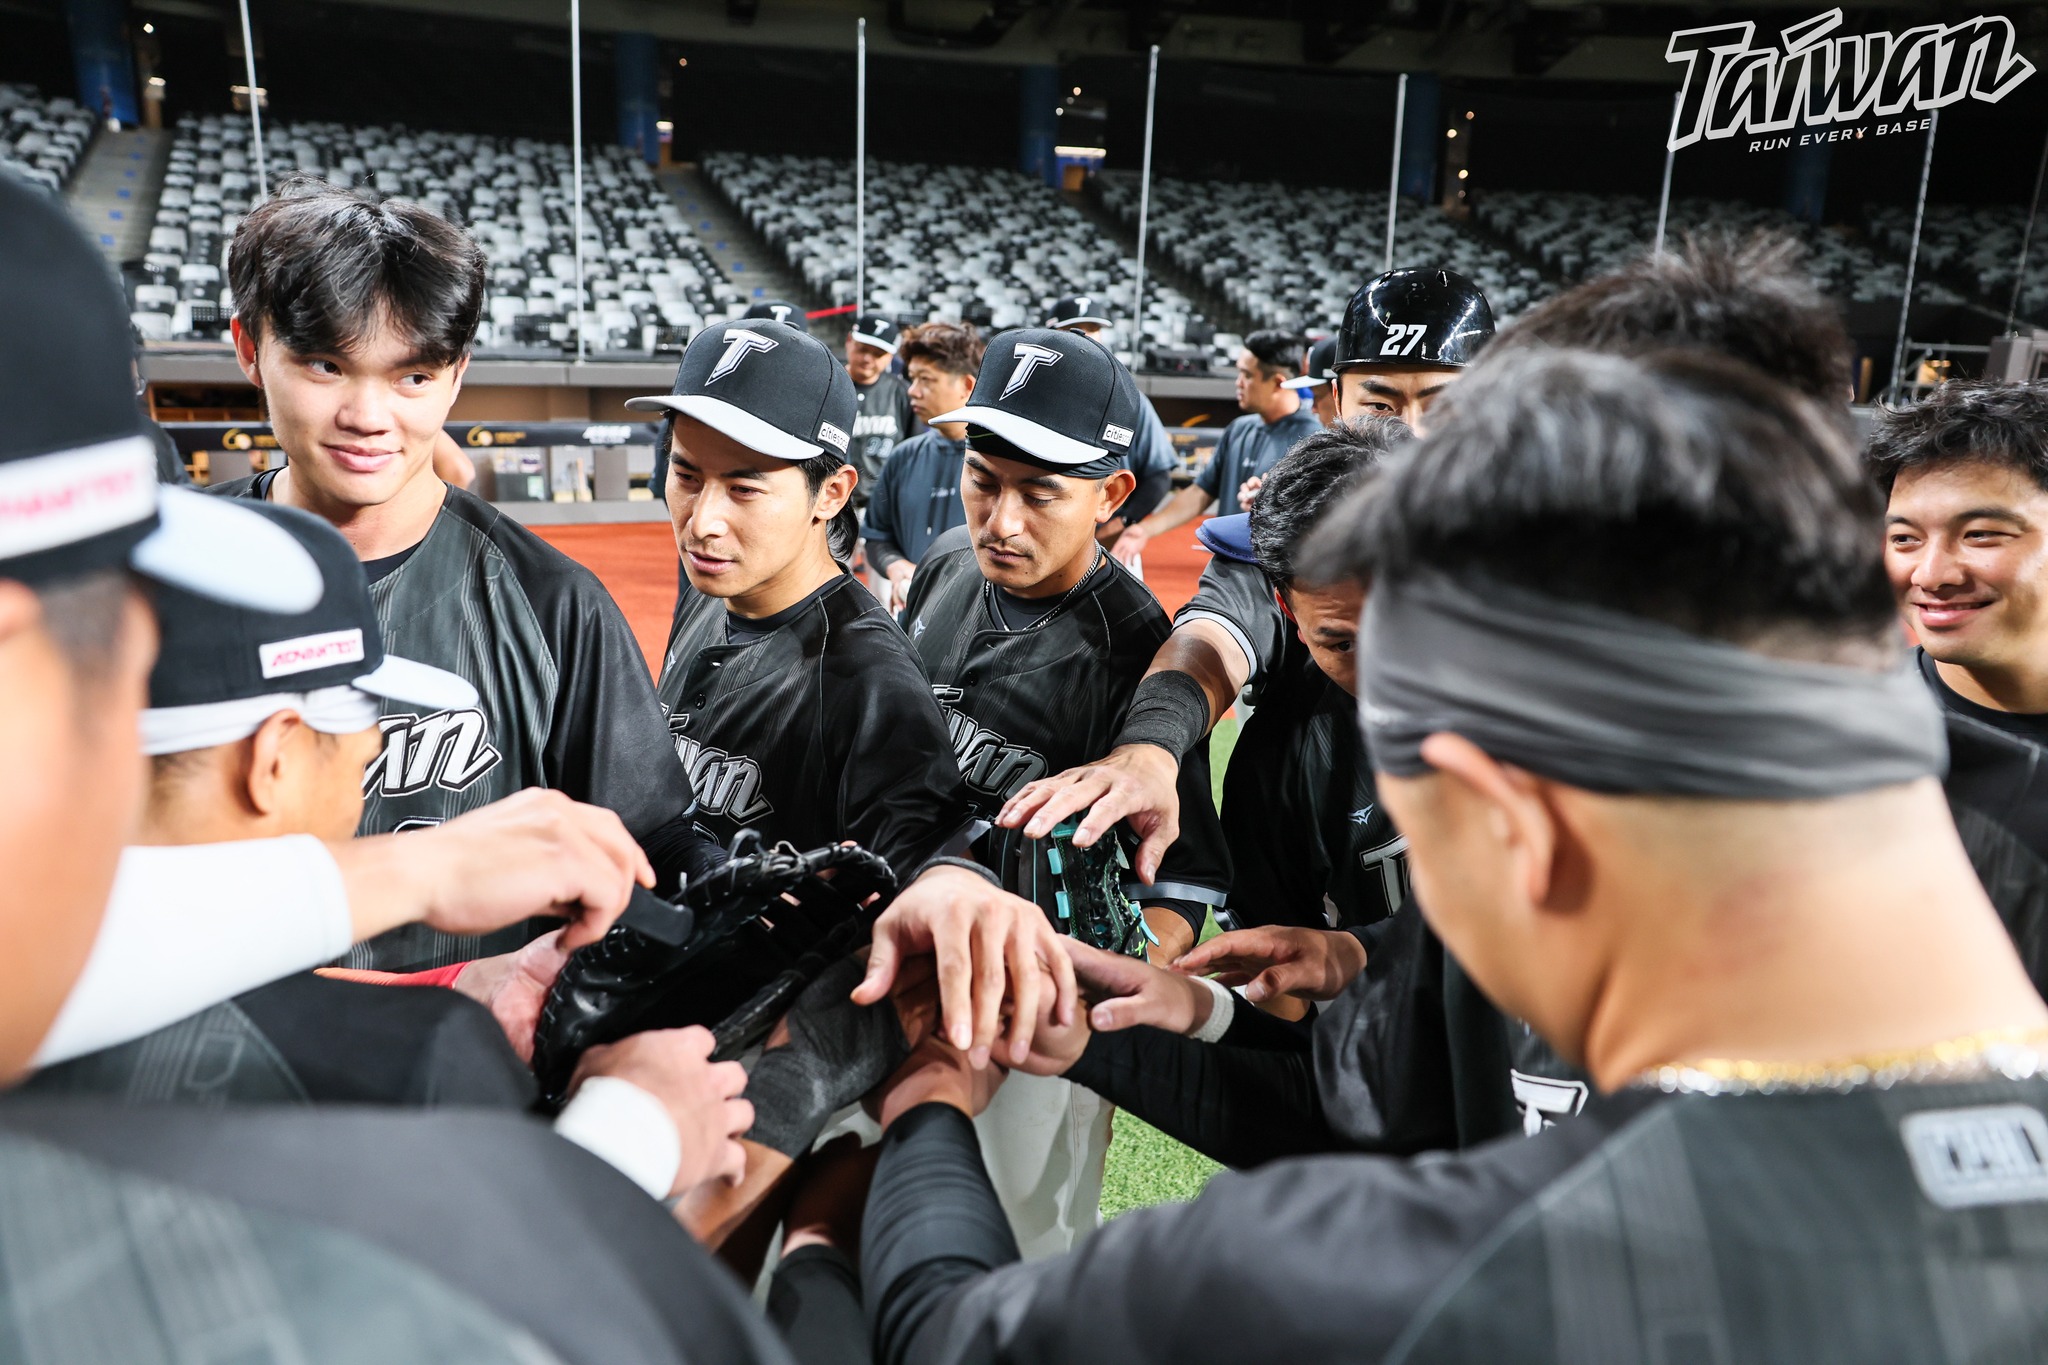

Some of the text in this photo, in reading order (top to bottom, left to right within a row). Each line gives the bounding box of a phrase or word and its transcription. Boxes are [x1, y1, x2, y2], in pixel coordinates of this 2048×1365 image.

[704, 328, 780, 387] T
[1380, 324, 1427, 356] 27
[999, 342, 1064, 401] T
